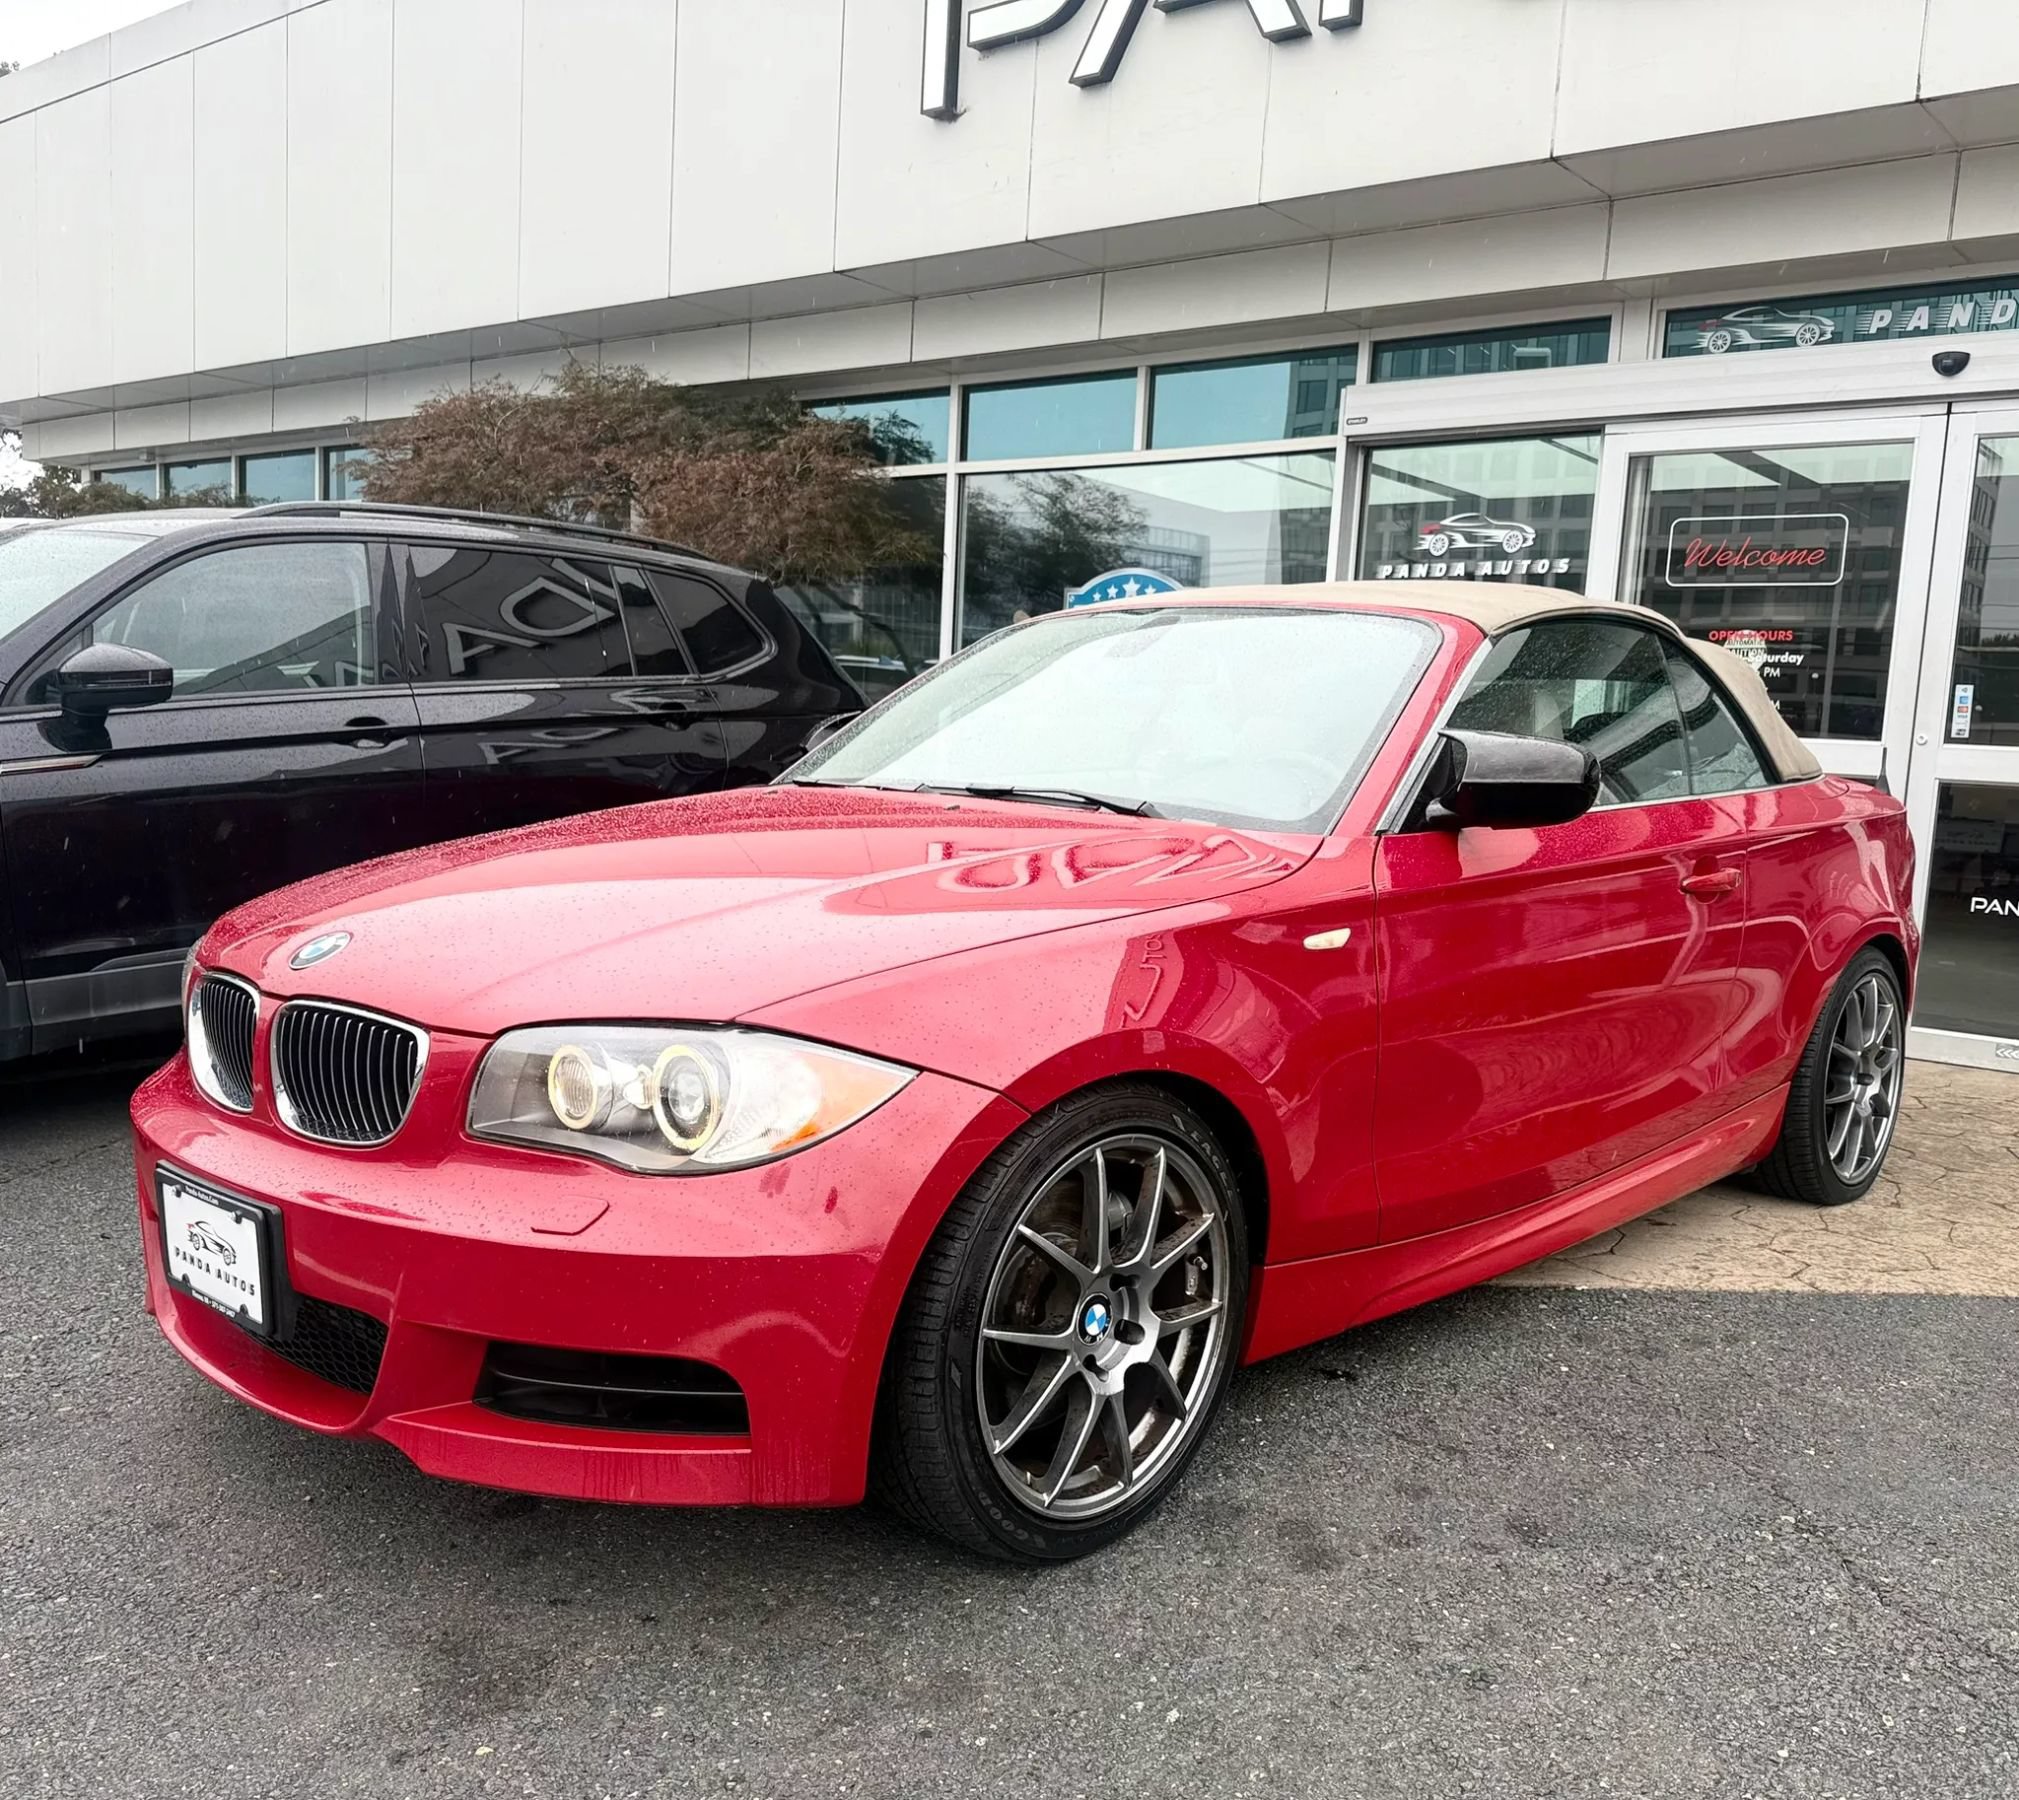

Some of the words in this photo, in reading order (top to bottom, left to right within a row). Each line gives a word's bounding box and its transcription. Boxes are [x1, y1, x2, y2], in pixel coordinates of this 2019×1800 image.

[1869, 299, 2017, 334] PAND
[1684, 536, 1827, 568] Welcome
[1378, 563, 1465, 579] PANDA
[1478, 558, 1570, 576] AUTOS
[1763, 666, 1780, 678] PM
[173, 1246, 211, 1275] PANDA
[216, 1268, 256, 1297] AUTOS
